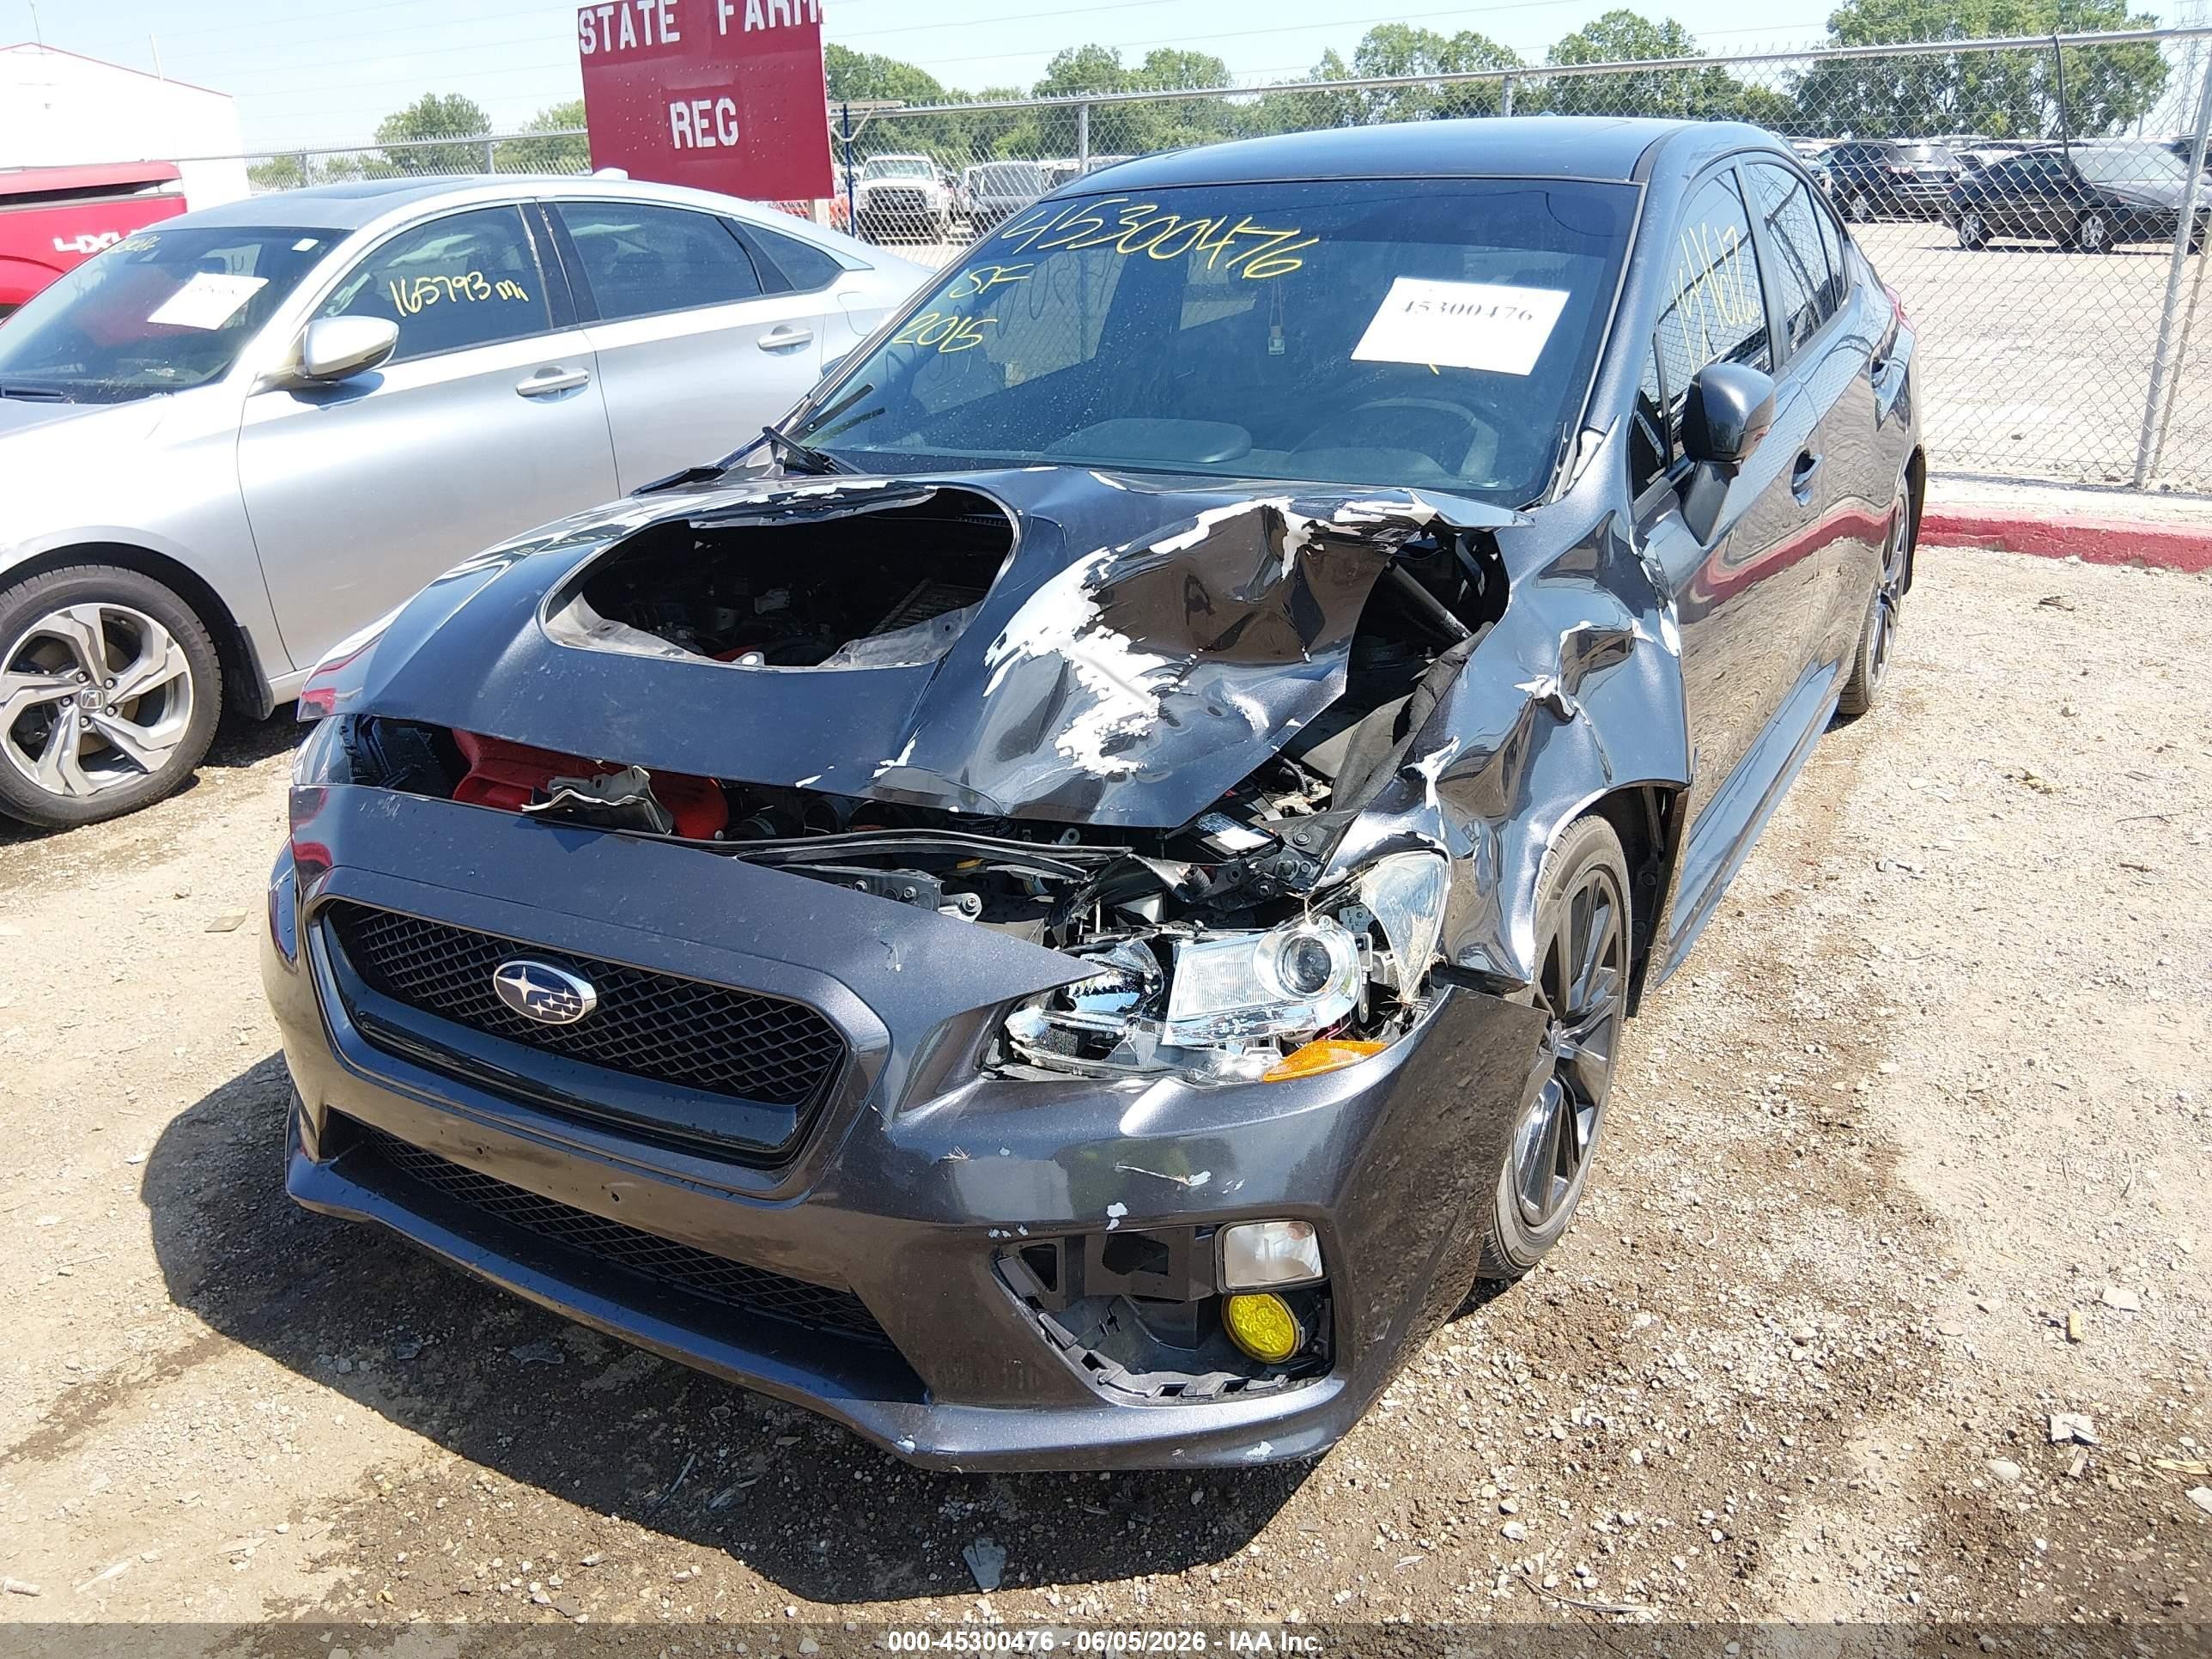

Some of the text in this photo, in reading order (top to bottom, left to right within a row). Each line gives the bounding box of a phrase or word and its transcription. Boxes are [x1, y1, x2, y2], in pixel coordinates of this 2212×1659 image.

[579, 0, 681, 54] STATE
[669, 97, 739, 149] REG
[1000, 198, 1320, 279] 45300476
[389, 270, 530, 317] 165793 mi
[948, 263, 1035, 299] SF
[891, 313, 999, 354] 2015
